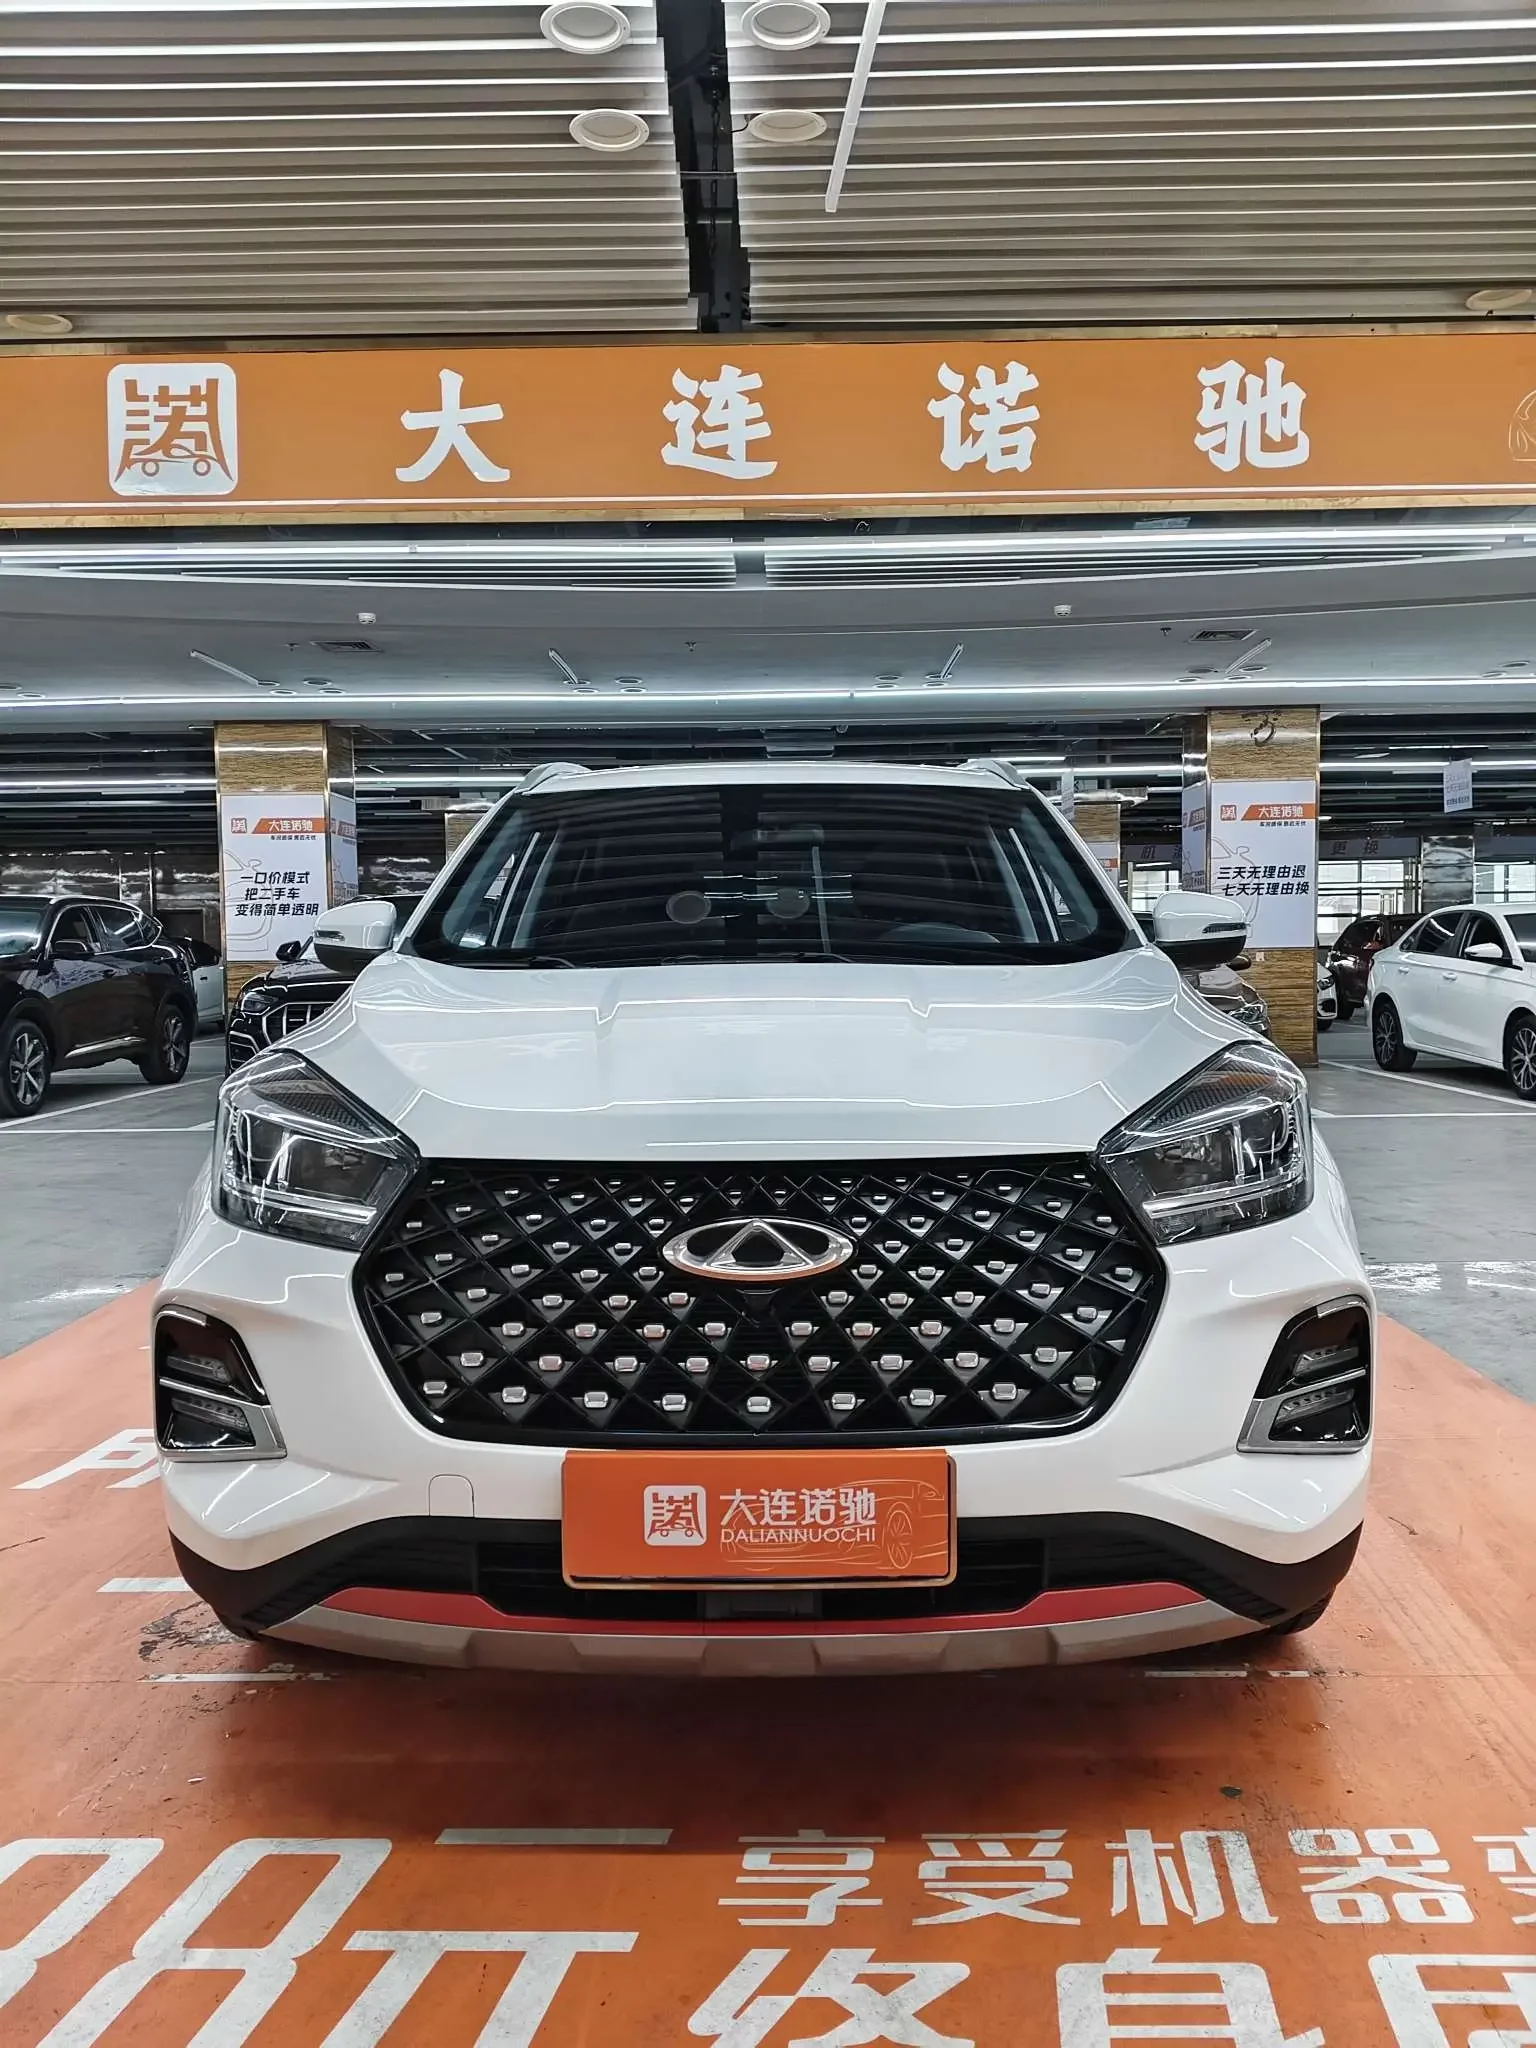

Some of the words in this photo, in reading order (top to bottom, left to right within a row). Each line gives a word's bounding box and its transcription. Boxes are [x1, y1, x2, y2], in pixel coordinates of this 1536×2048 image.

[396, 357, 1309, 482] 大连诺驰
[1258, 805, 1304, 817] 大连诺驰
[268, 819, 313, 832] 大连诺驰
[240, 871, 310, 885] 一口价模式
[1217, 864, 1306, 880] 三天无理由退
[244, 887, 300, 901] 把二手车
[1222, 881, 1309, 896] 七天无理由换
[234, 903, 320, 917] 变得简单透明
[720, 1487, 877, 1526] 大连诺驰
[721, 1528, 876, 1543] DALIANNUOCHI
